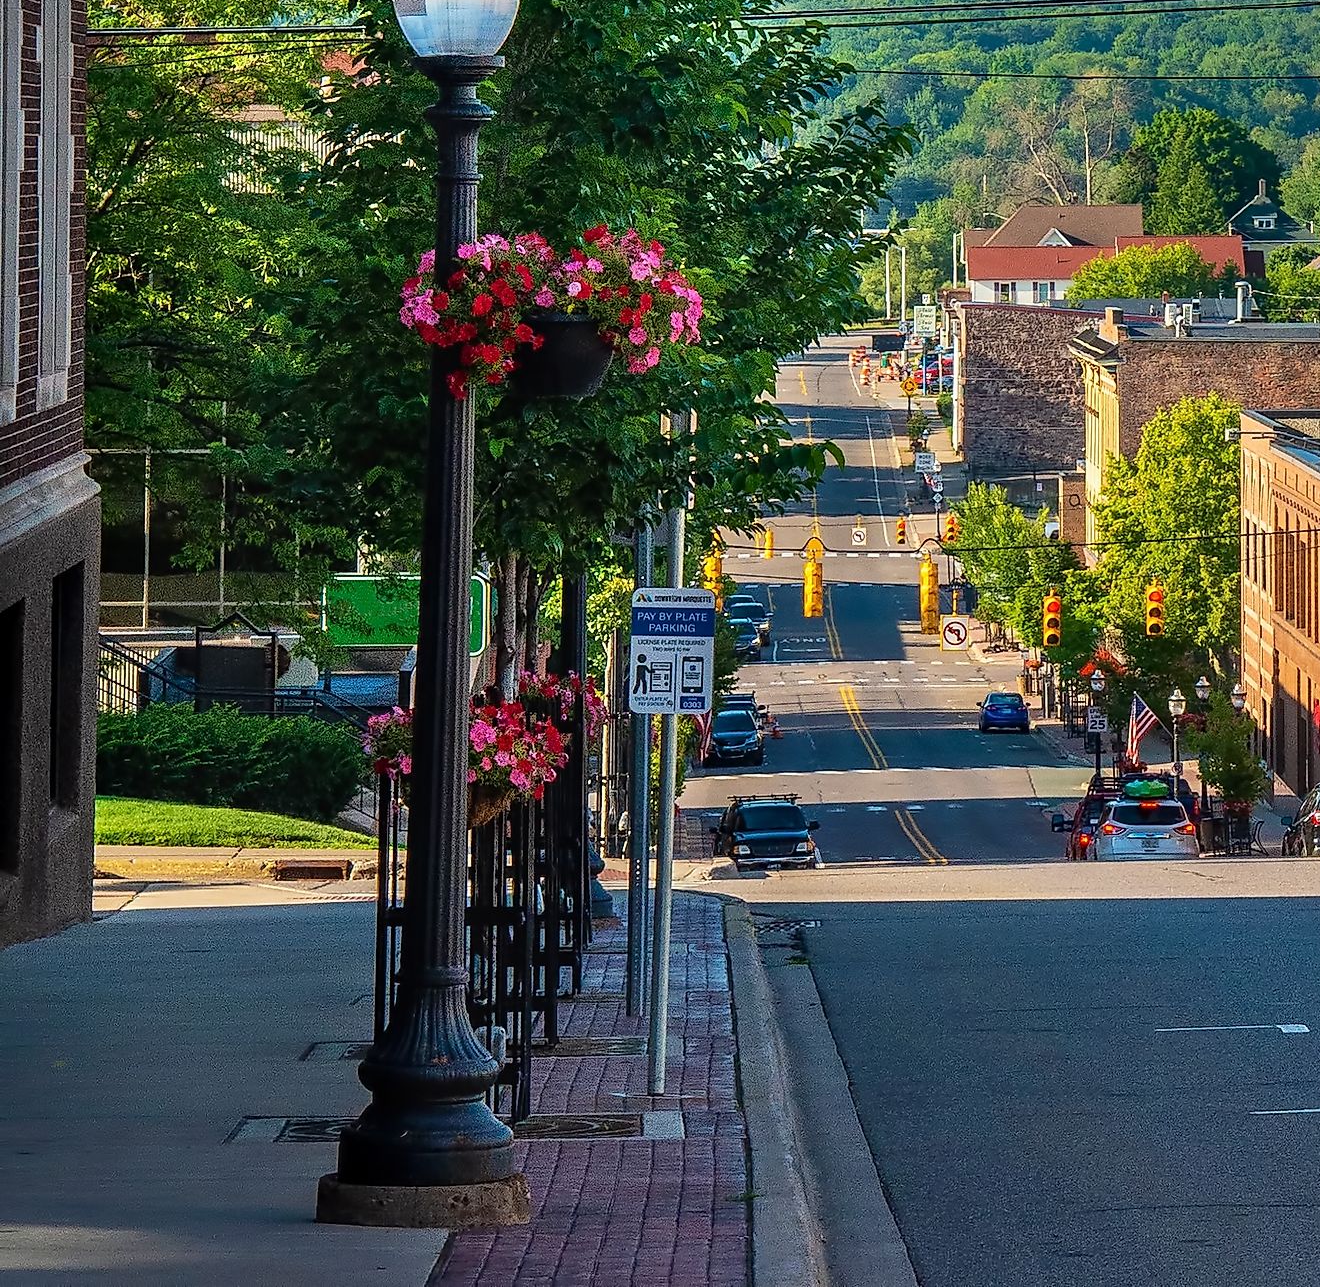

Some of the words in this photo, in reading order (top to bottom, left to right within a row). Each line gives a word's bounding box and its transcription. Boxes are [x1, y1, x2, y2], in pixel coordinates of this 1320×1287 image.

[637, 612, 656, 621] PAY
[659, 612, 673, 621] BY
[675, 612, 708, 622] PLATE
[648, 623, 696, 633] PARKING
[682, 701, 702, 709] 0303
[1090, 720, 1105, 729] 25
